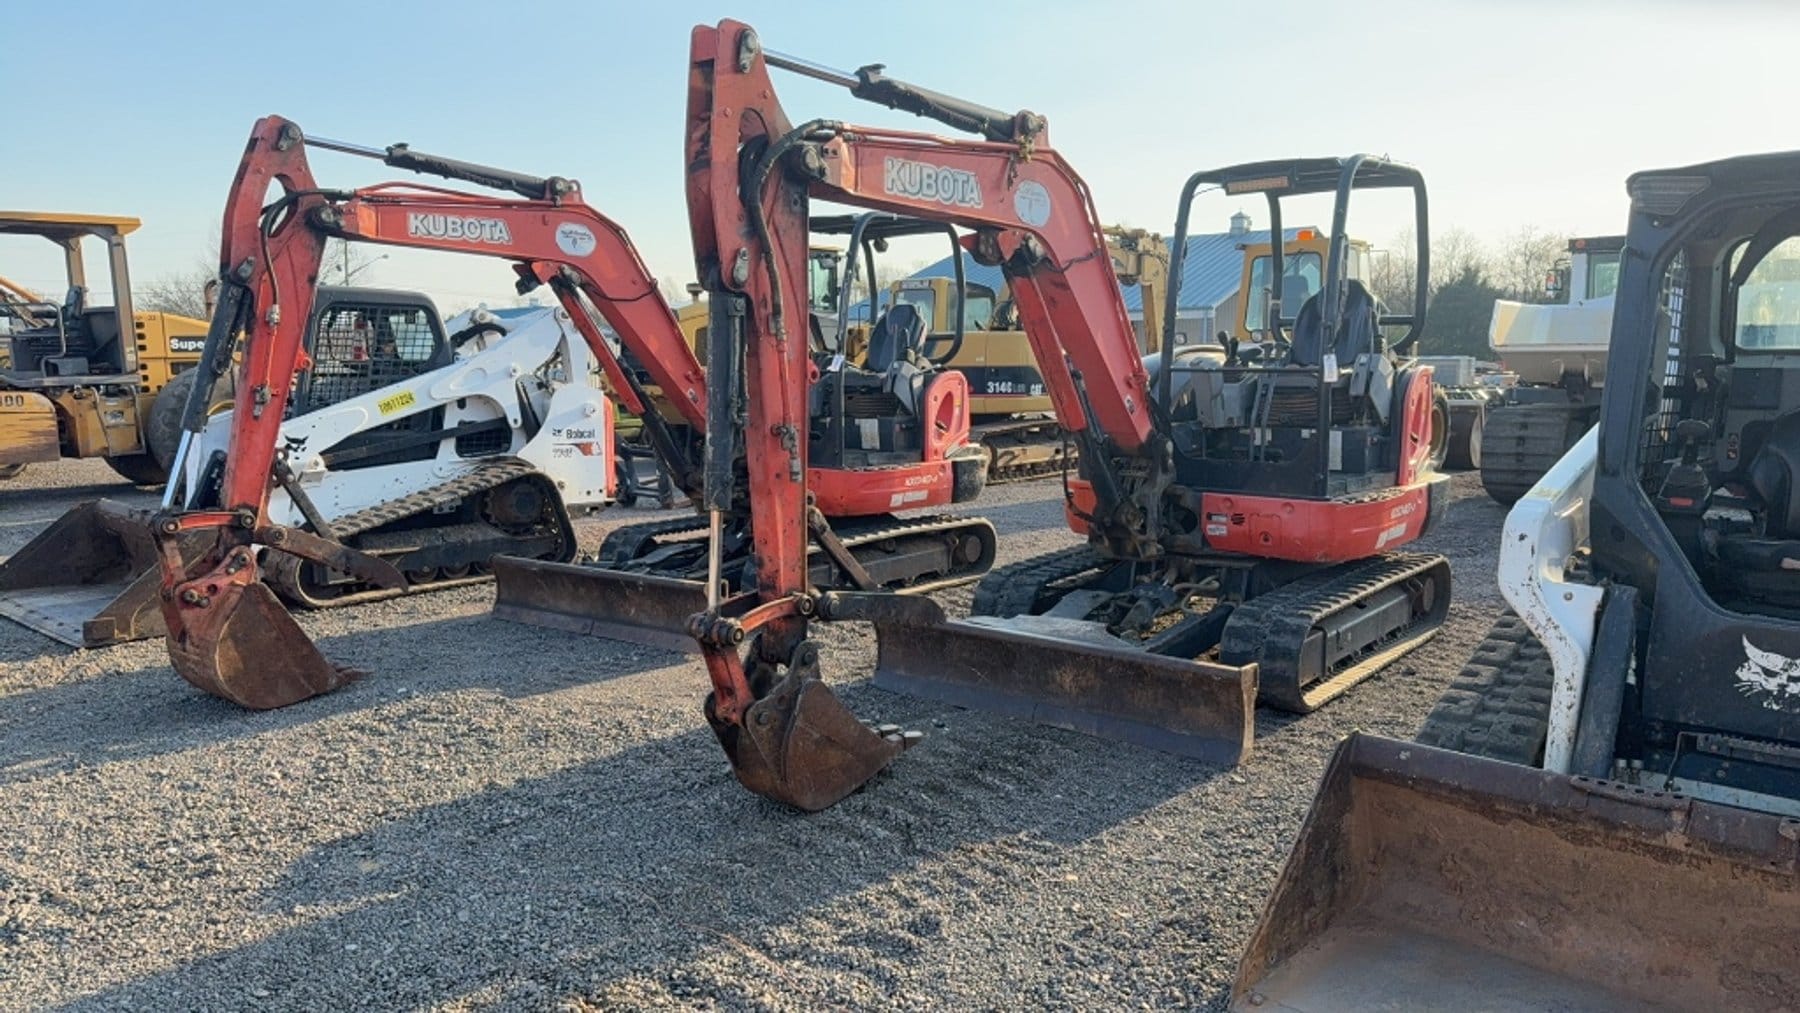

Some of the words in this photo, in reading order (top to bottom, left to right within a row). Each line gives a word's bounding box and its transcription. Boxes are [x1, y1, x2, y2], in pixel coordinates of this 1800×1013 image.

[884, 157, 983, 206] KUBOTA
[408, 212, 512, 244] KUBOTA
[0, 394, 24, 408] 00
